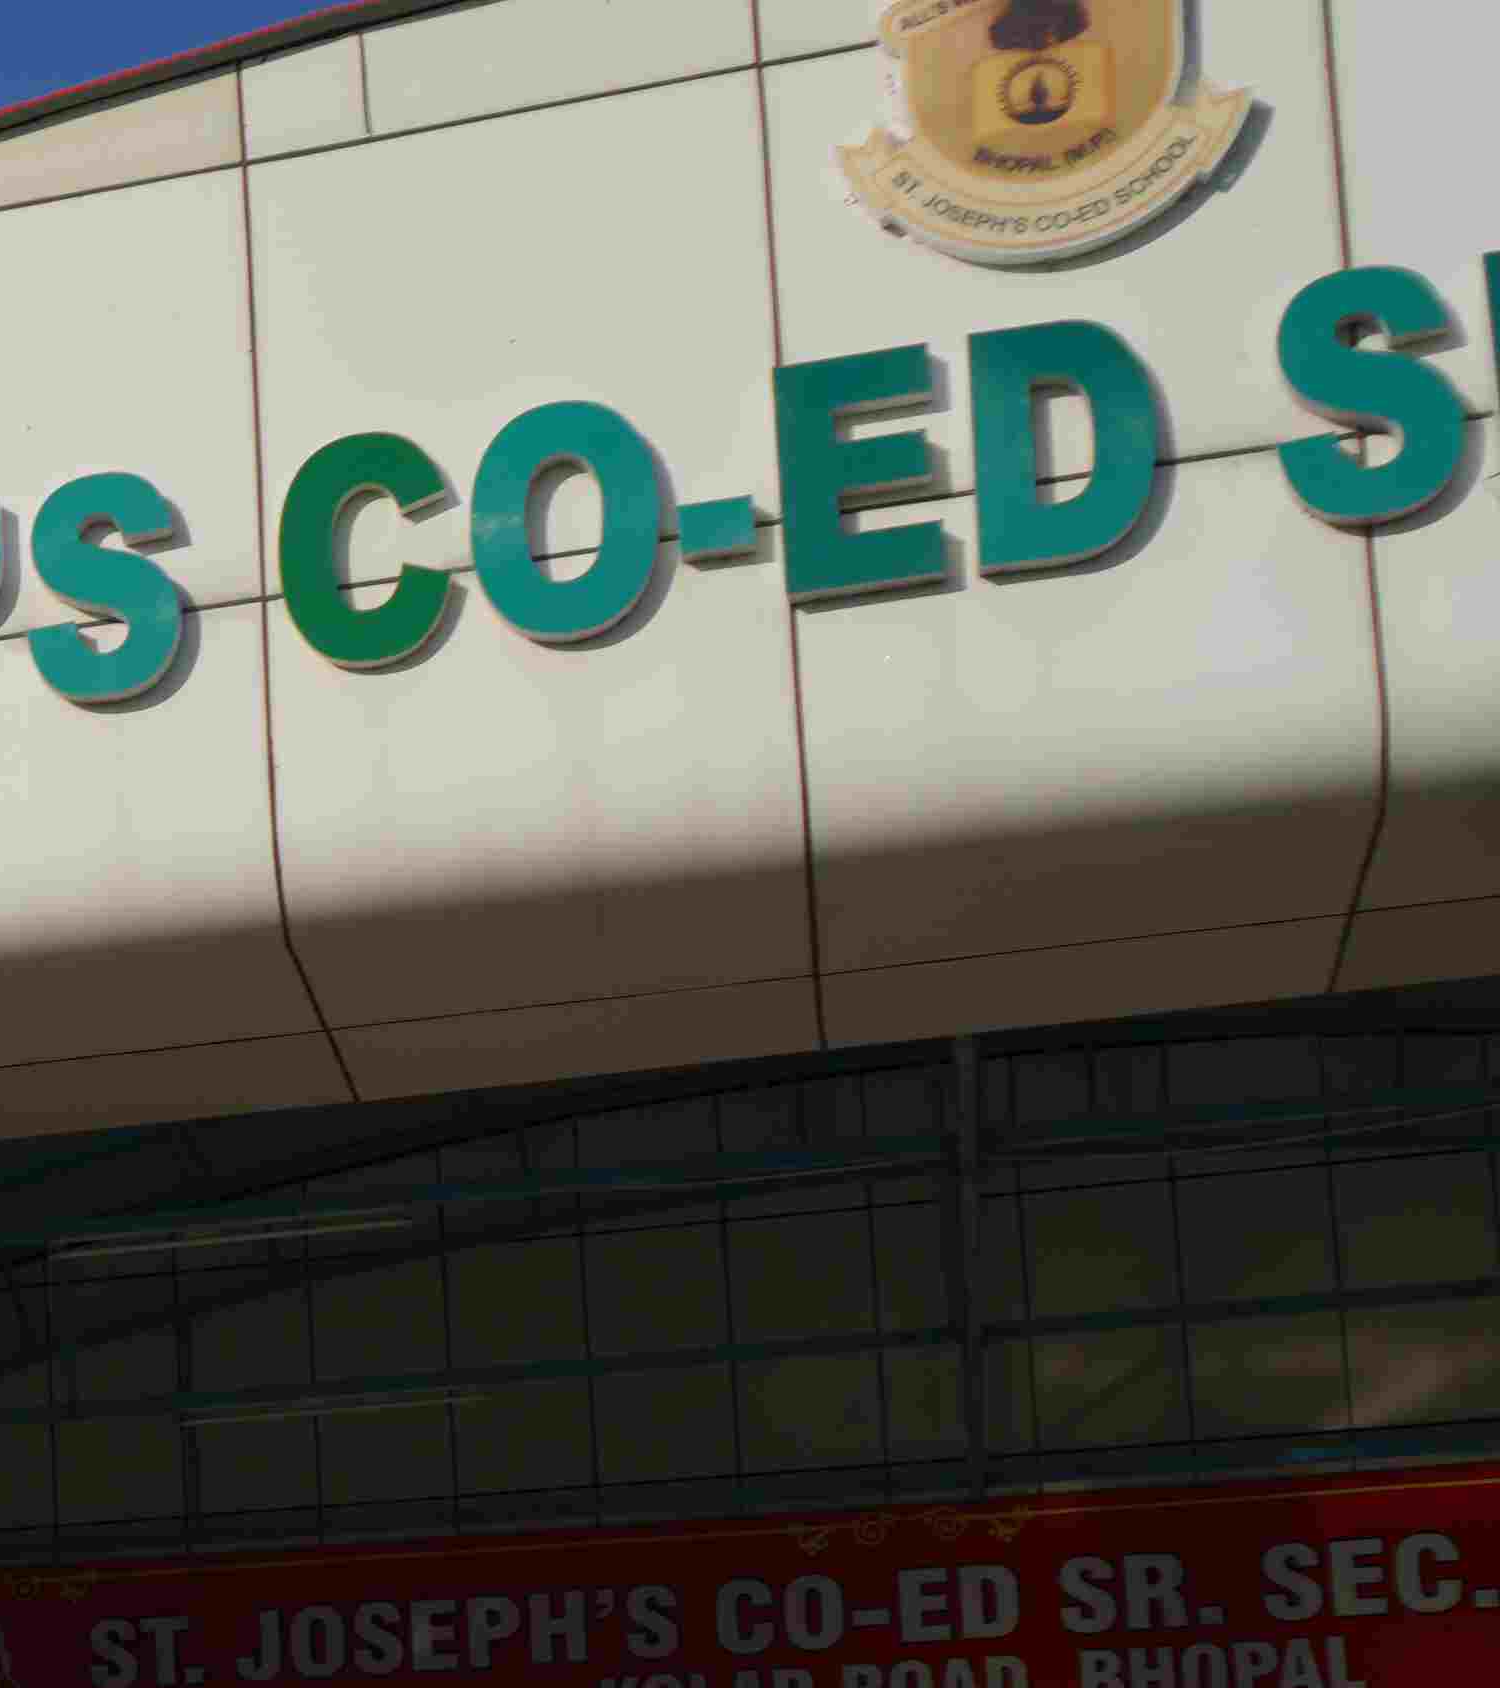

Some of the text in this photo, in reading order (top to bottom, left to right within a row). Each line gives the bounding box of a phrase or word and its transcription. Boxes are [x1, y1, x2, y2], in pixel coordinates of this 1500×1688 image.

[892, 133, 1198, 235] ST. JOSEPH'S CO-ED SCHOOL
[279, 319, 1161, 668] CO-ED
[235, 1584, 679, 1684] JOSEPH'S
[716, 1563, 1021, 1655] CO-ED
[1059, 1553, 1223, 1634] SR.
[1261, 1531, 1500, 1623] SEC.
